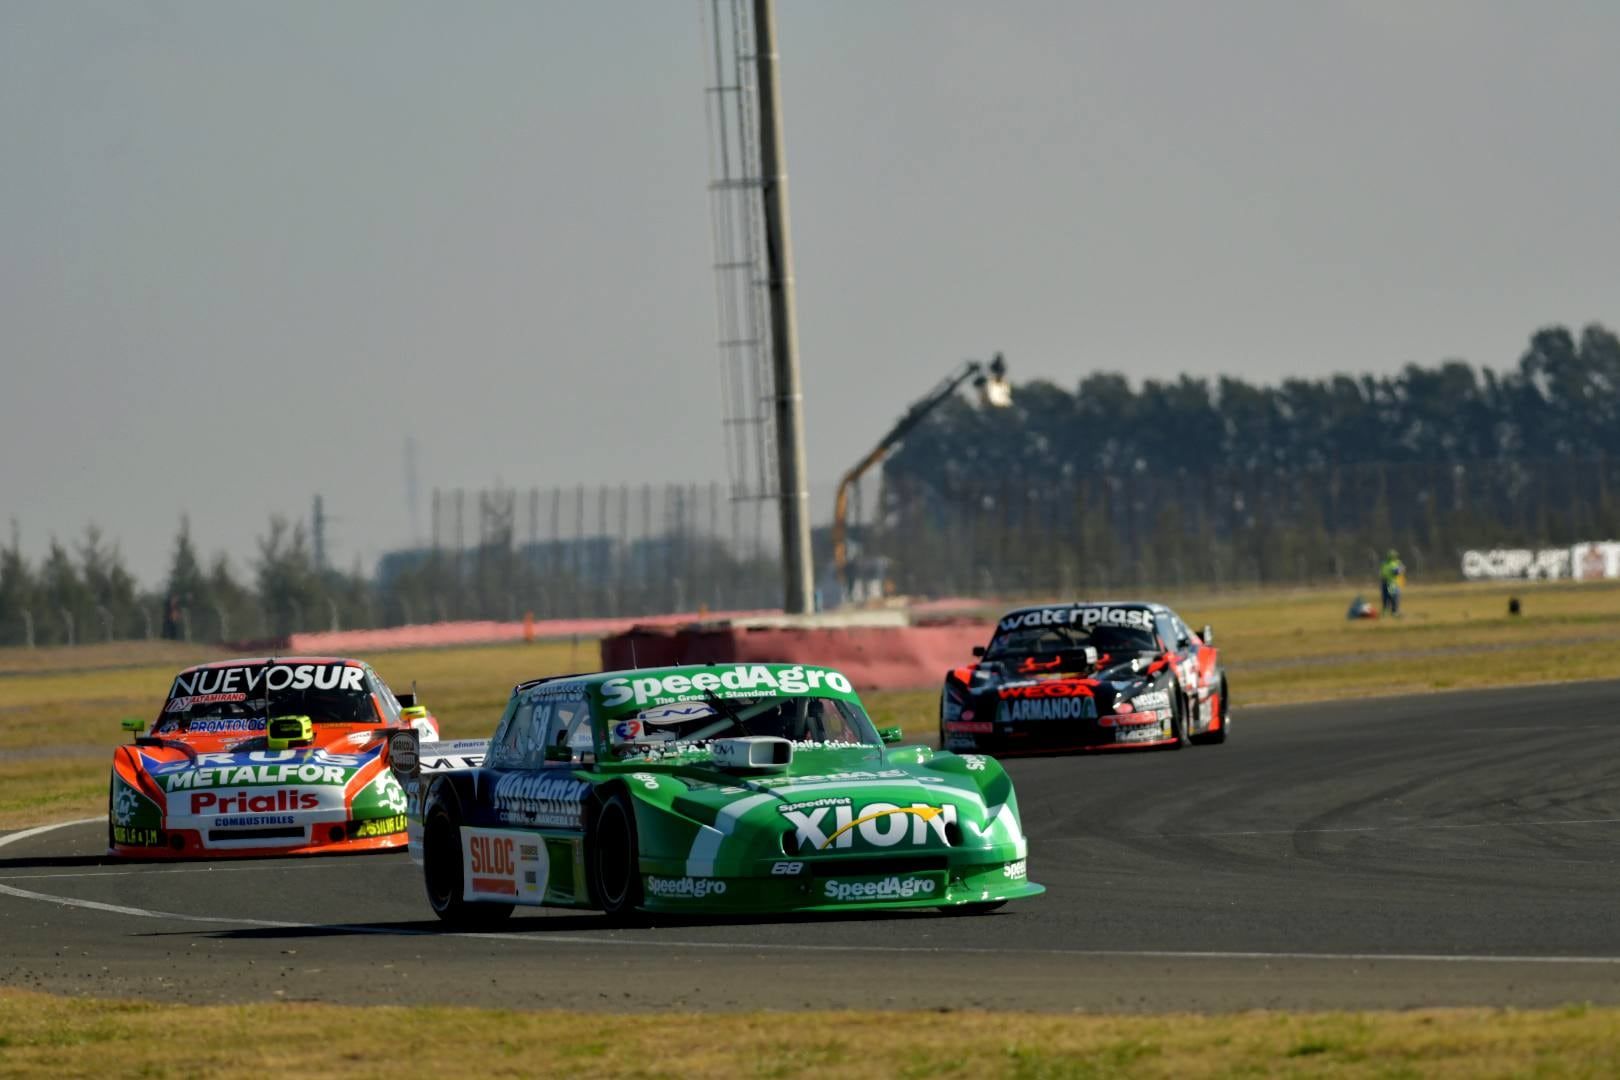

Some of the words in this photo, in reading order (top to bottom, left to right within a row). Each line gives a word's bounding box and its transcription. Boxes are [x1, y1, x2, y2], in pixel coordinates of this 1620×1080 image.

[1001, 607, 1154, 631] waterplast
[600, 665, 852, 707] SpeedAgro
[655, 696, 675, 704] The
[725, 689, 777, 698] Standard
[1012, 698, 1081, 720] ARMANDO
[166, 764, 345, 793] METALFOR
[190, 789, 319, 815] Prialis
[778, 798, 852, 813] SpeedWet
[215, 816, 294, 827] COMBUSTIBLES
[782, 802, 958, 850] XION
[469, 836, 516, 875] SILOC
[771, 862, 802, 876] 68
[647, 875, 727, 898] SpeedAgro
[824, 875, 936, 900] SpeedAgro
